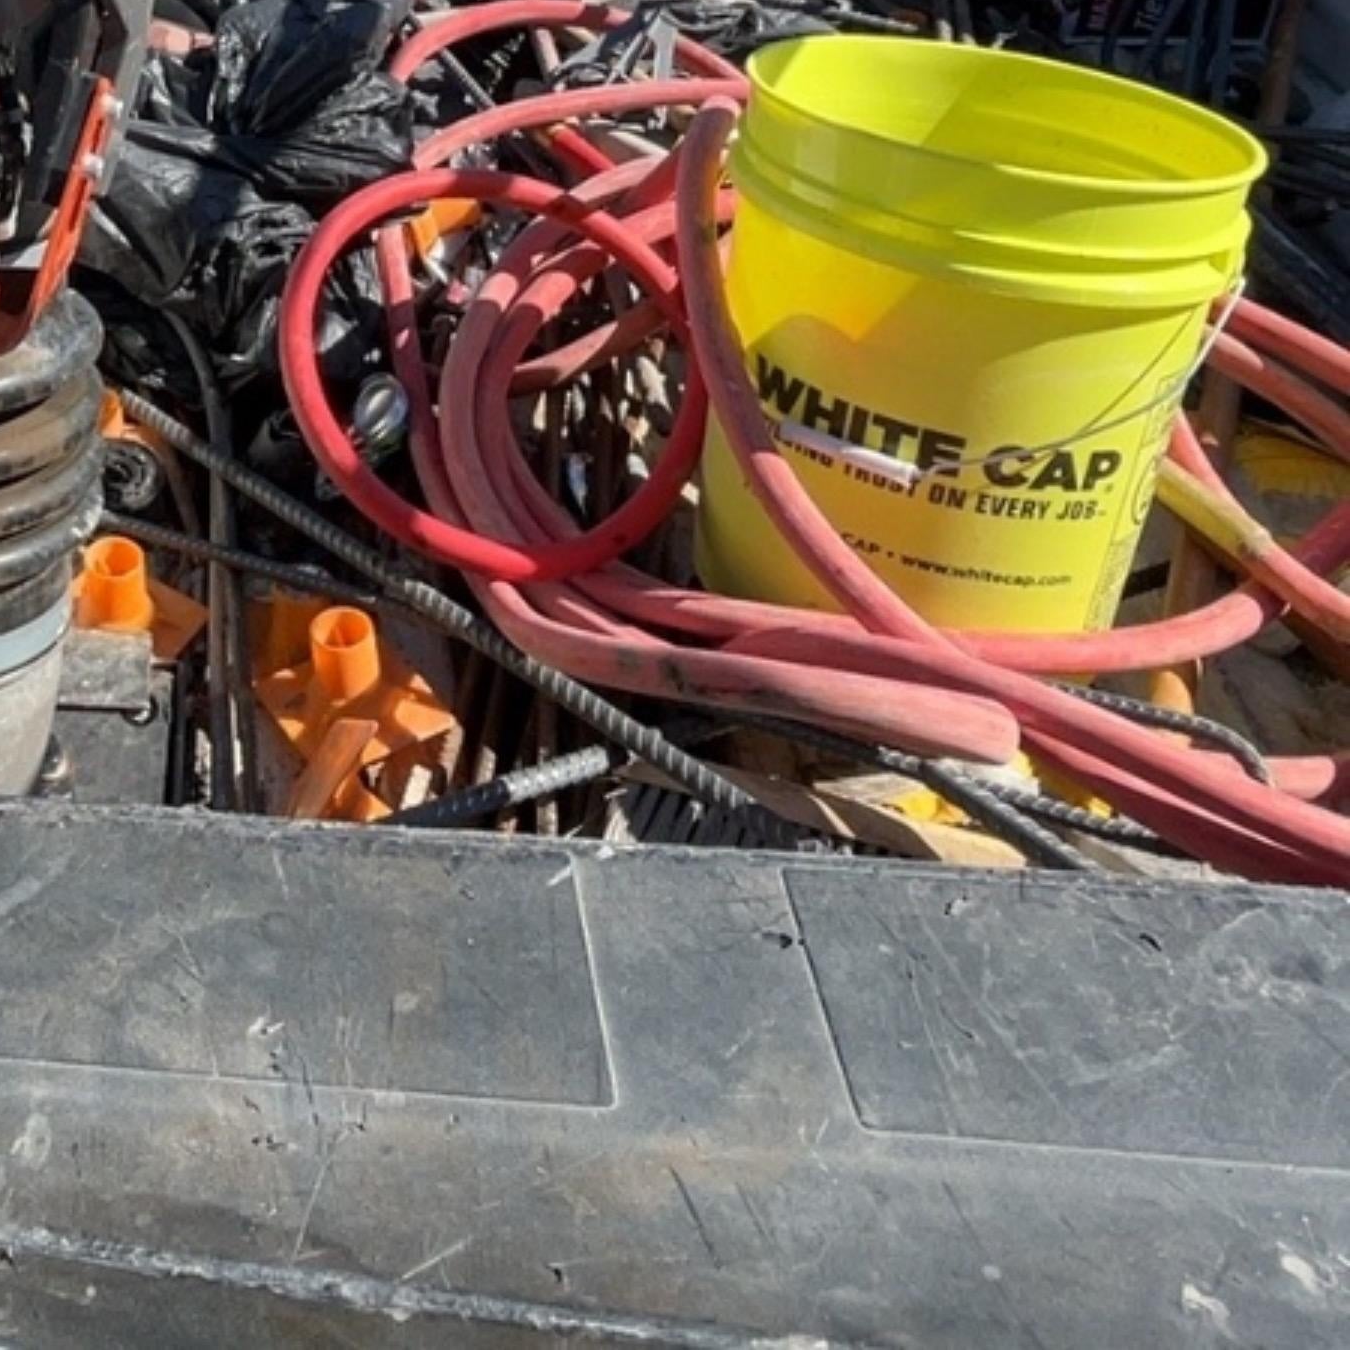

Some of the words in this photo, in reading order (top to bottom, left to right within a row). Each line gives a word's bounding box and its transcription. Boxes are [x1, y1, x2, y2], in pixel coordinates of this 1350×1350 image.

[756, 353, 967, 478] WHITE
[983, 443, 1122, 492] CAP
[928, 482, 967, 509] ON
[975, 492, 1052, 520] EVERY
[901, 554, 1073, 588] www.whitecap.com
